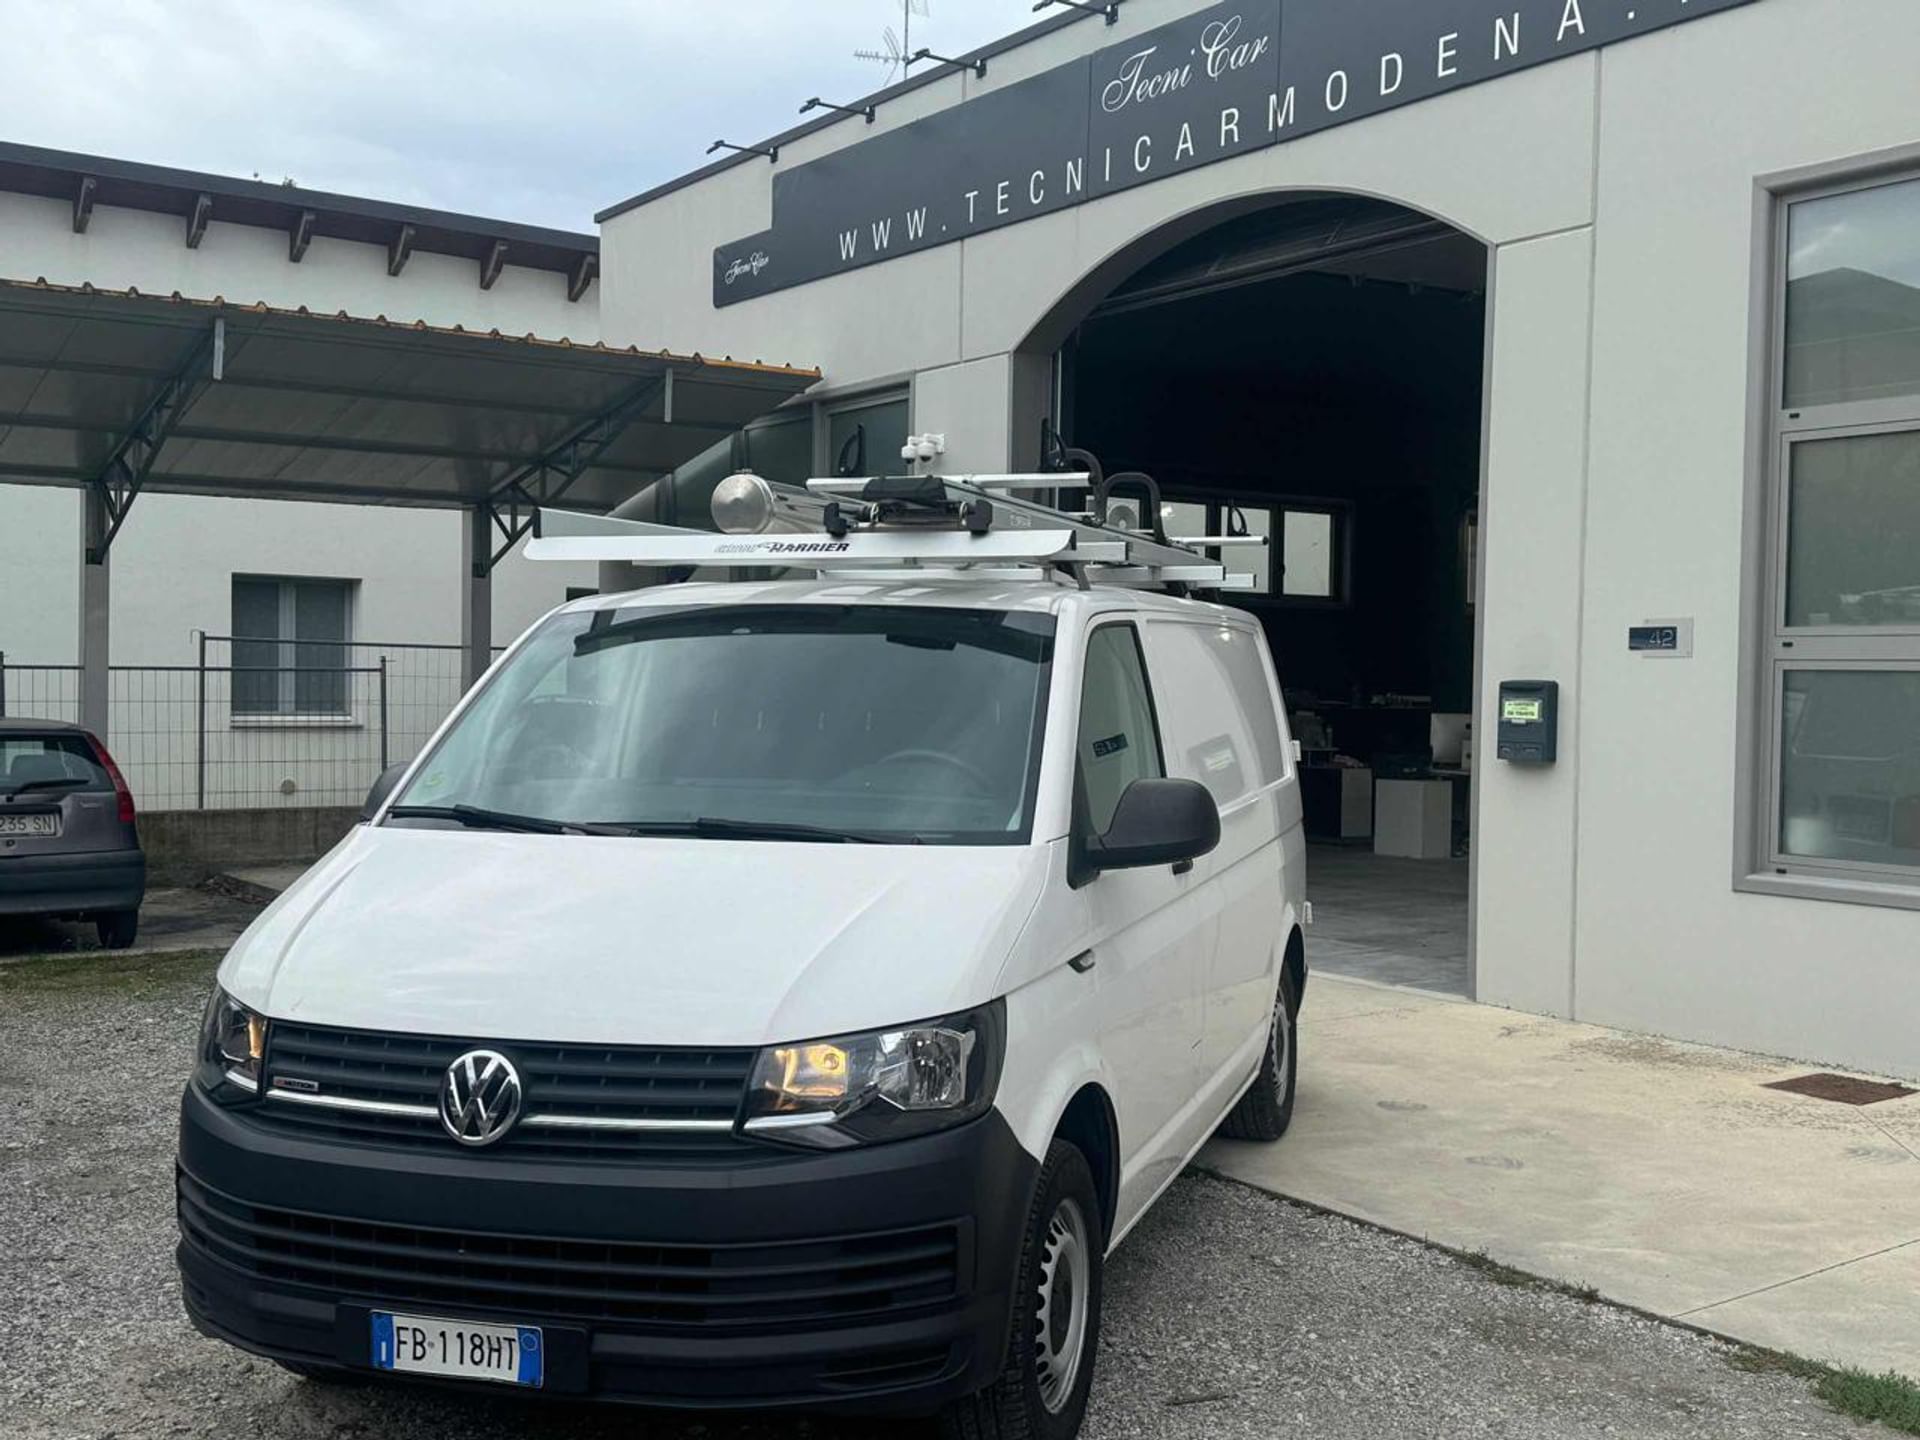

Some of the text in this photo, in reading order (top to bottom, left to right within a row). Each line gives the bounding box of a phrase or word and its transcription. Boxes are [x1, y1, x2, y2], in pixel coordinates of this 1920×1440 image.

[1102, 15, 1268, 112] Tecni Car
[839, 0, 1688, 261] WWW.TECNICARMODENA.
[1650, 630, 1674, 647] 42
[33, 816, 51, 831] SN
[396, 1326, 426, 1361] FB
[439, 1330, 516, 1371] 118HT
